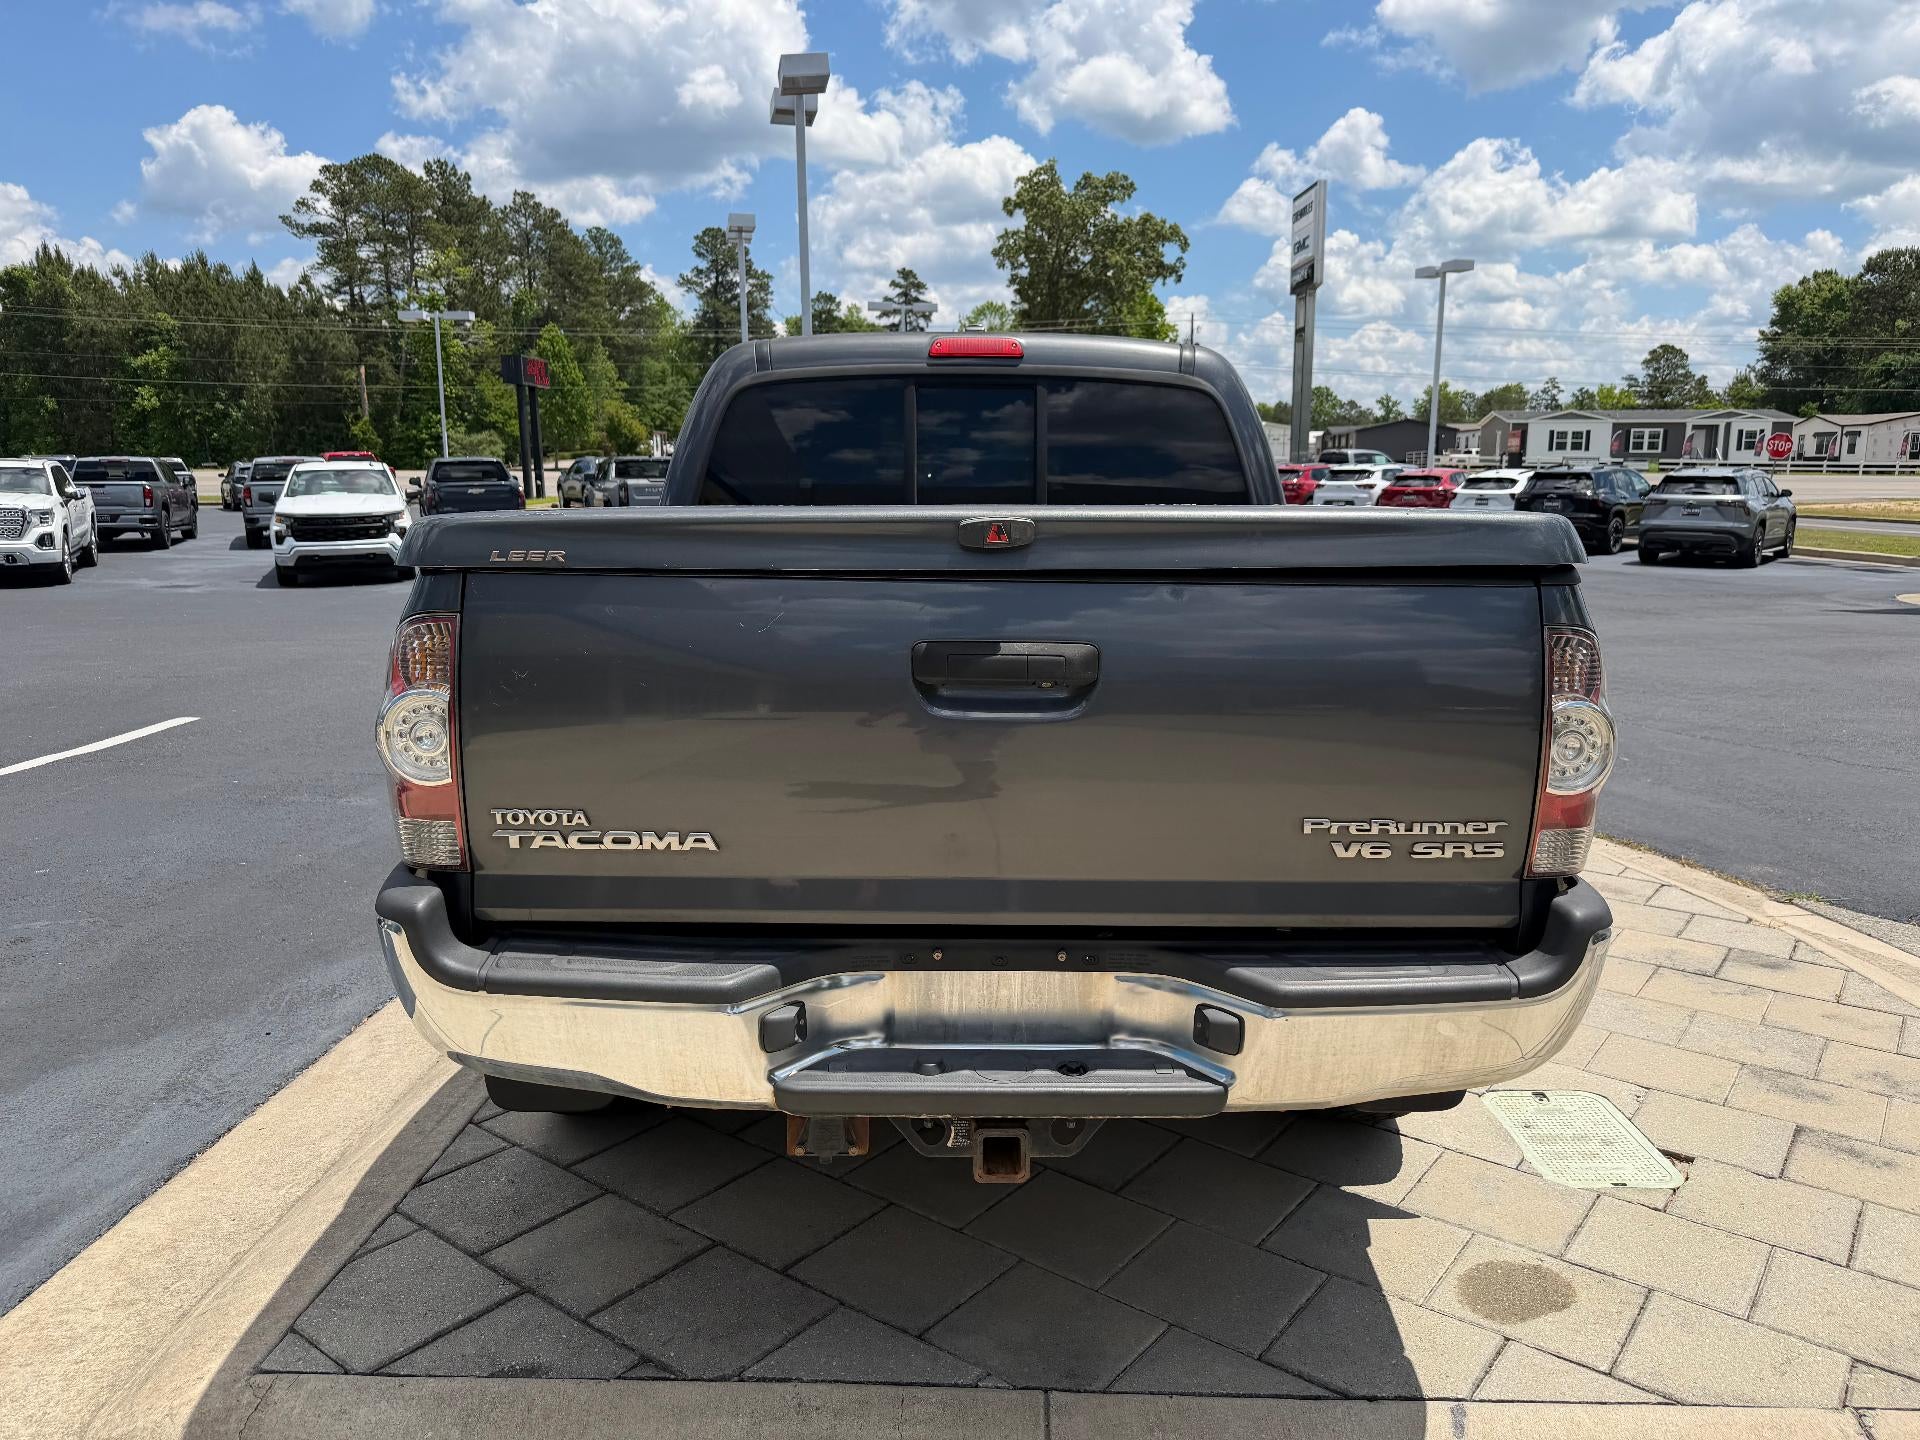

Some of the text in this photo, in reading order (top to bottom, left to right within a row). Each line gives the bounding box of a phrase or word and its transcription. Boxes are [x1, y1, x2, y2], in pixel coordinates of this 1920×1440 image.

[1293, 235, 1310, 256] GMC
[1767, 440, 1792, 452] STOP
[489, 550, 566, 562] LEER
[490, 808, 590, 827] TOYOTA
[1303, 818, 1509, 835] PreRunner
[492, 829, 720, 852] TACOMA
[1330, 841, 1505, 859] V6 SR5
